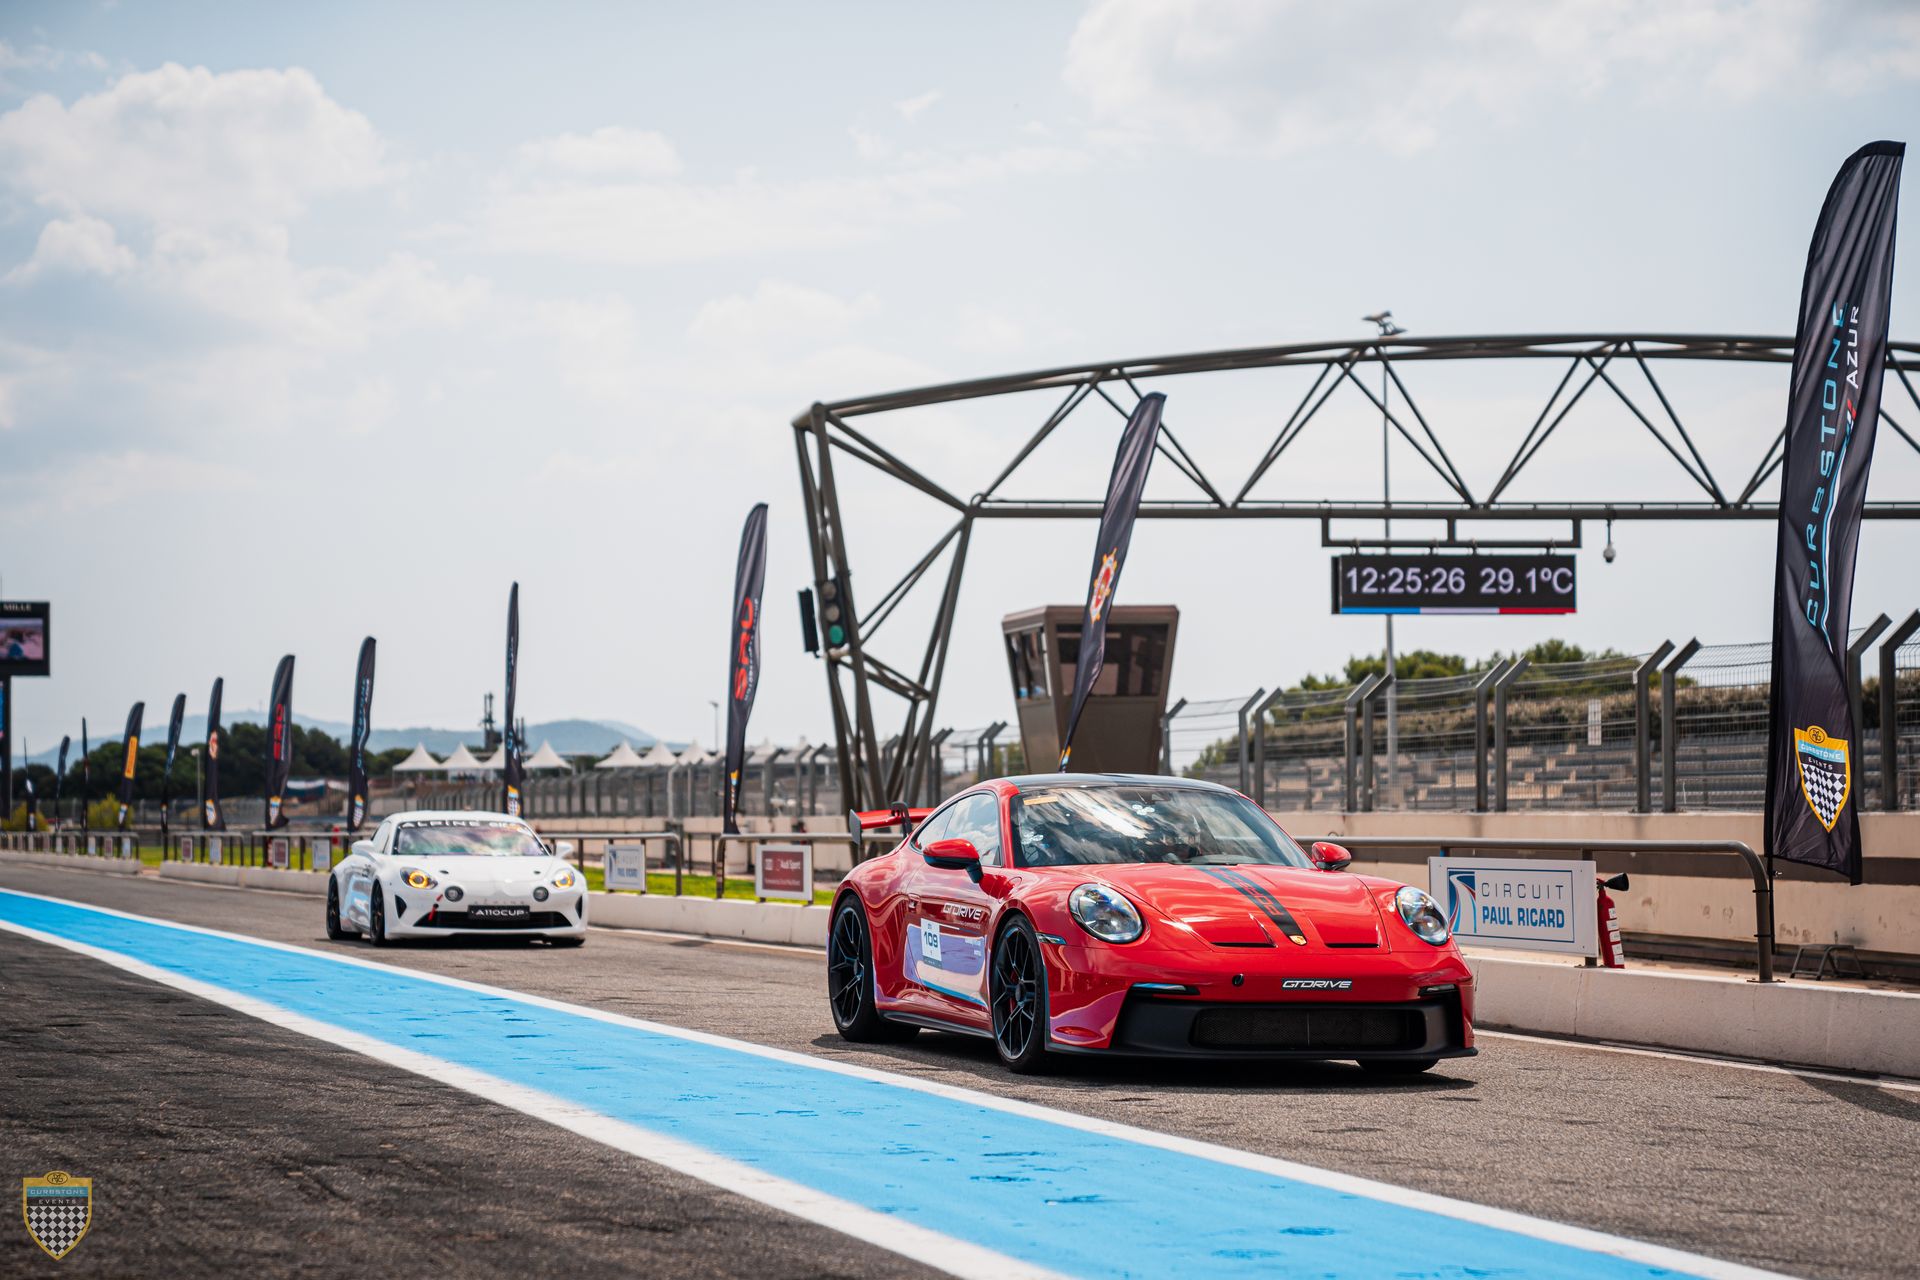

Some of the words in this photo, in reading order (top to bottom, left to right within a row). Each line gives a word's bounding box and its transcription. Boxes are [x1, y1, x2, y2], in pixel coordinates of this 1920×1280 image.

[1846, 305, 1860, 389] AZUR
[1805, 301, 1849, 627] CURBSTONE
[1347, 566, 1466, 594] 12:25:26
[3, 604, 32, 612] MILLE
[402, 820, 481, 829] ALPINE
[1481, 882, 1564, 900] CIRCUIT
[942, 902, 982, 920] GTDRIVE
[1482, 906, 1514, 926] PAUL
[1517, 907, 1565, 929] RICARD
[923, 931, 939, 948] 109
[1282, 980, 1353, 989] GTDRIVE
